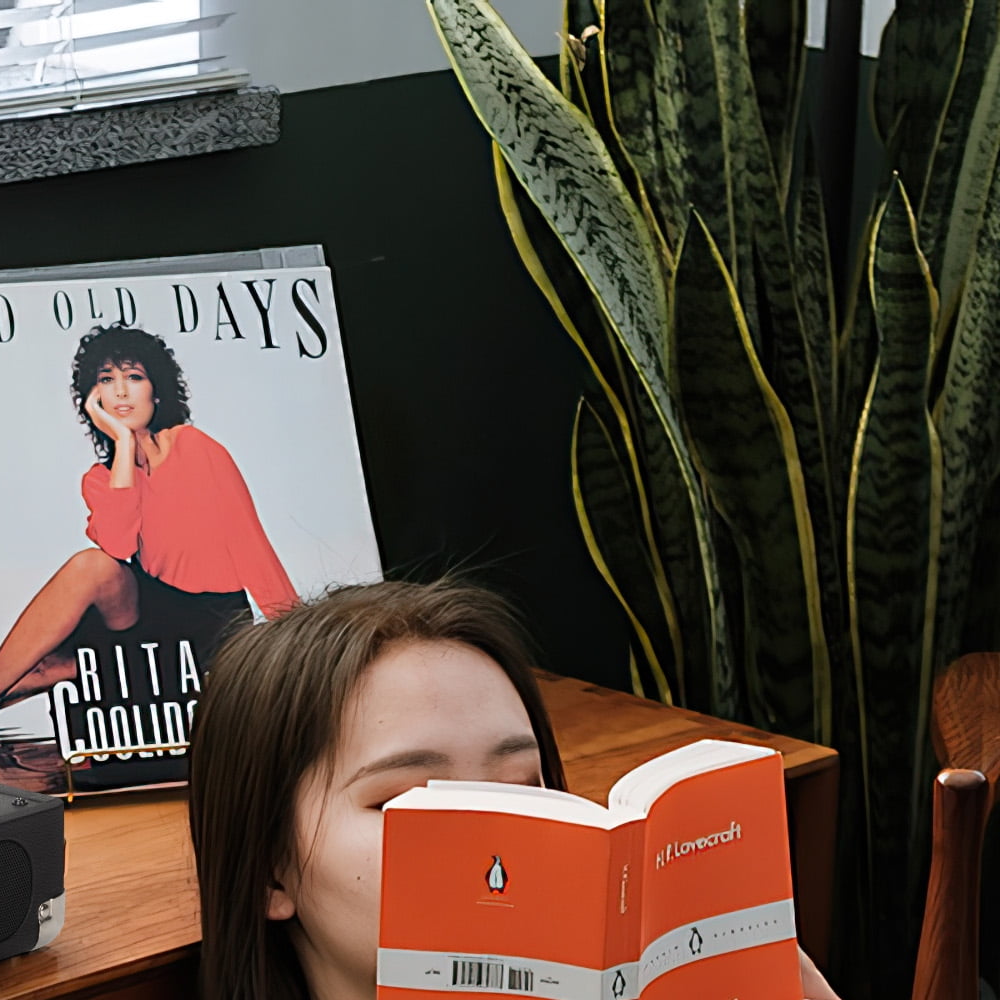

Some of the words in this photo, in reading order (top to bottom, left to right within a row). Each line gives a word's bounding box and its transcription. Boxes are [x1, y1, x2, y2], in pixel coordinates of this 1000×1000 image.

[53, 286, 137, 330] OLD
[171, 278, 328, 359] DAYS
[77, 640, 201, 702] RITA
